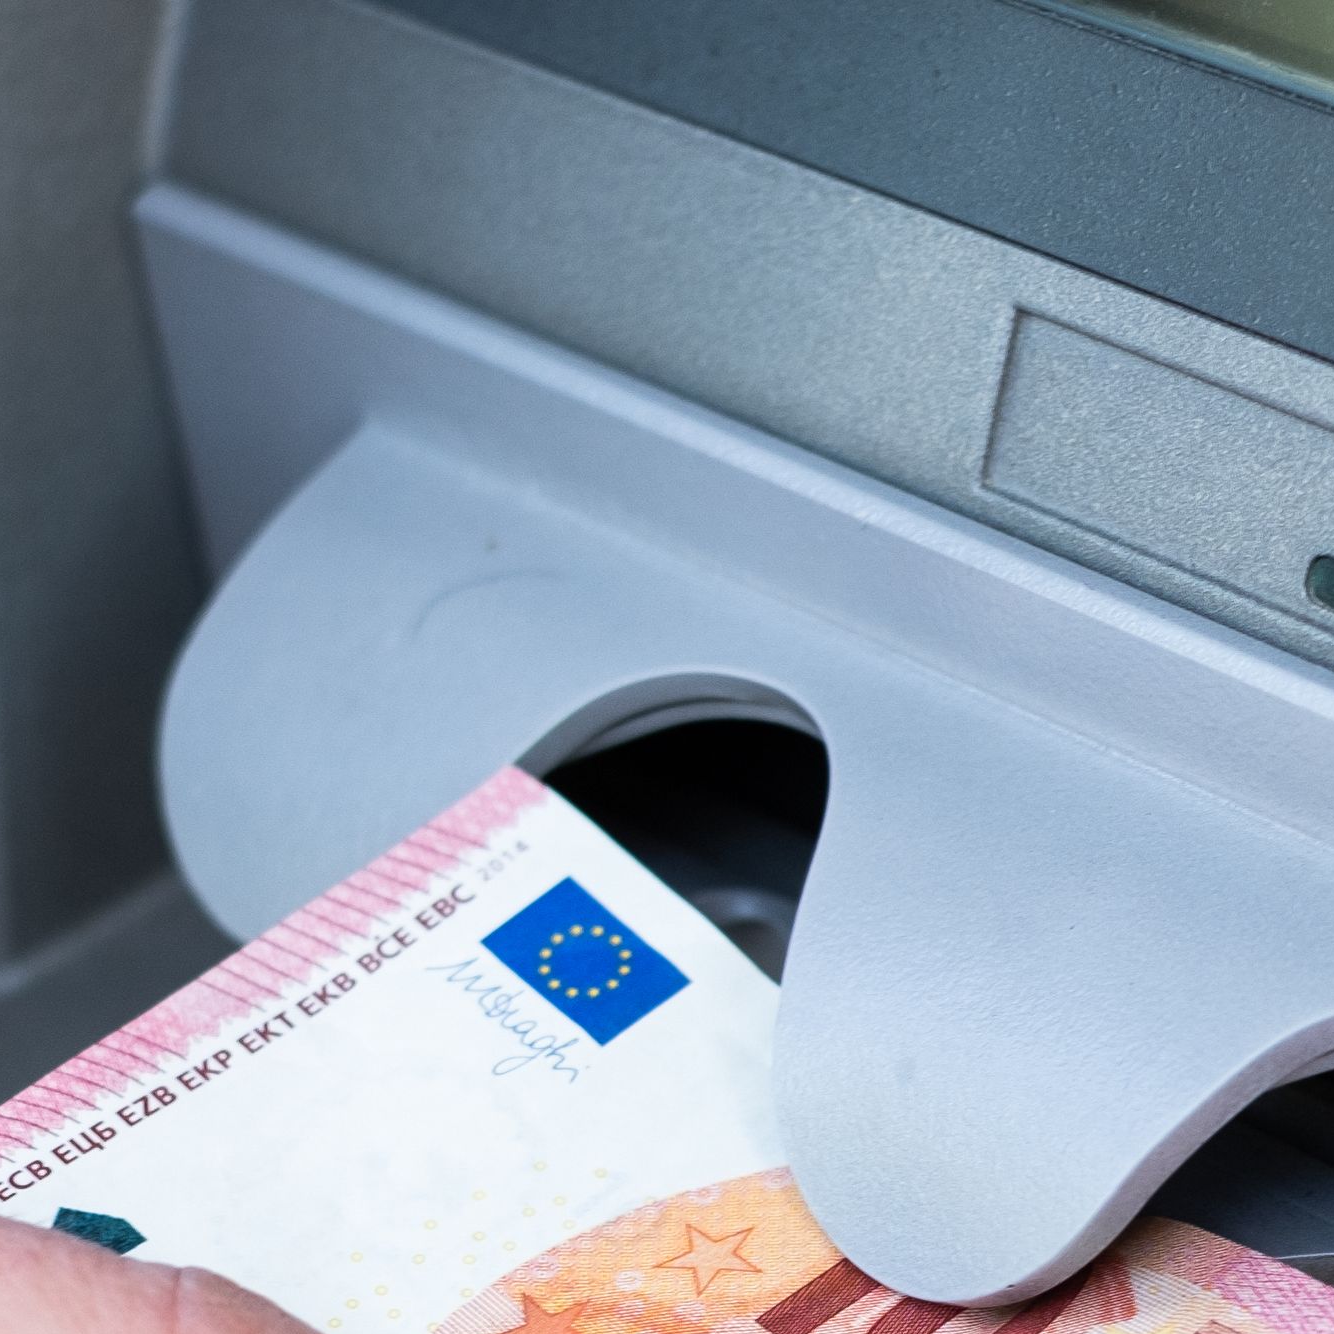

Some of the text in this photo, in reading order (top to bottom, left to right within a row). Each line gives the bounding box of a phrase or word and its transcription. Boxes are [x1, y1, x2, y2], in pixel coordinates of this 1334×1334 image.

[116, 1085, 177, 1127] EZB
[176, 1049, 232, 1091] EKP
[296, 972, 357, 1017] EKB
[414, 883, 476, 931] EBC
